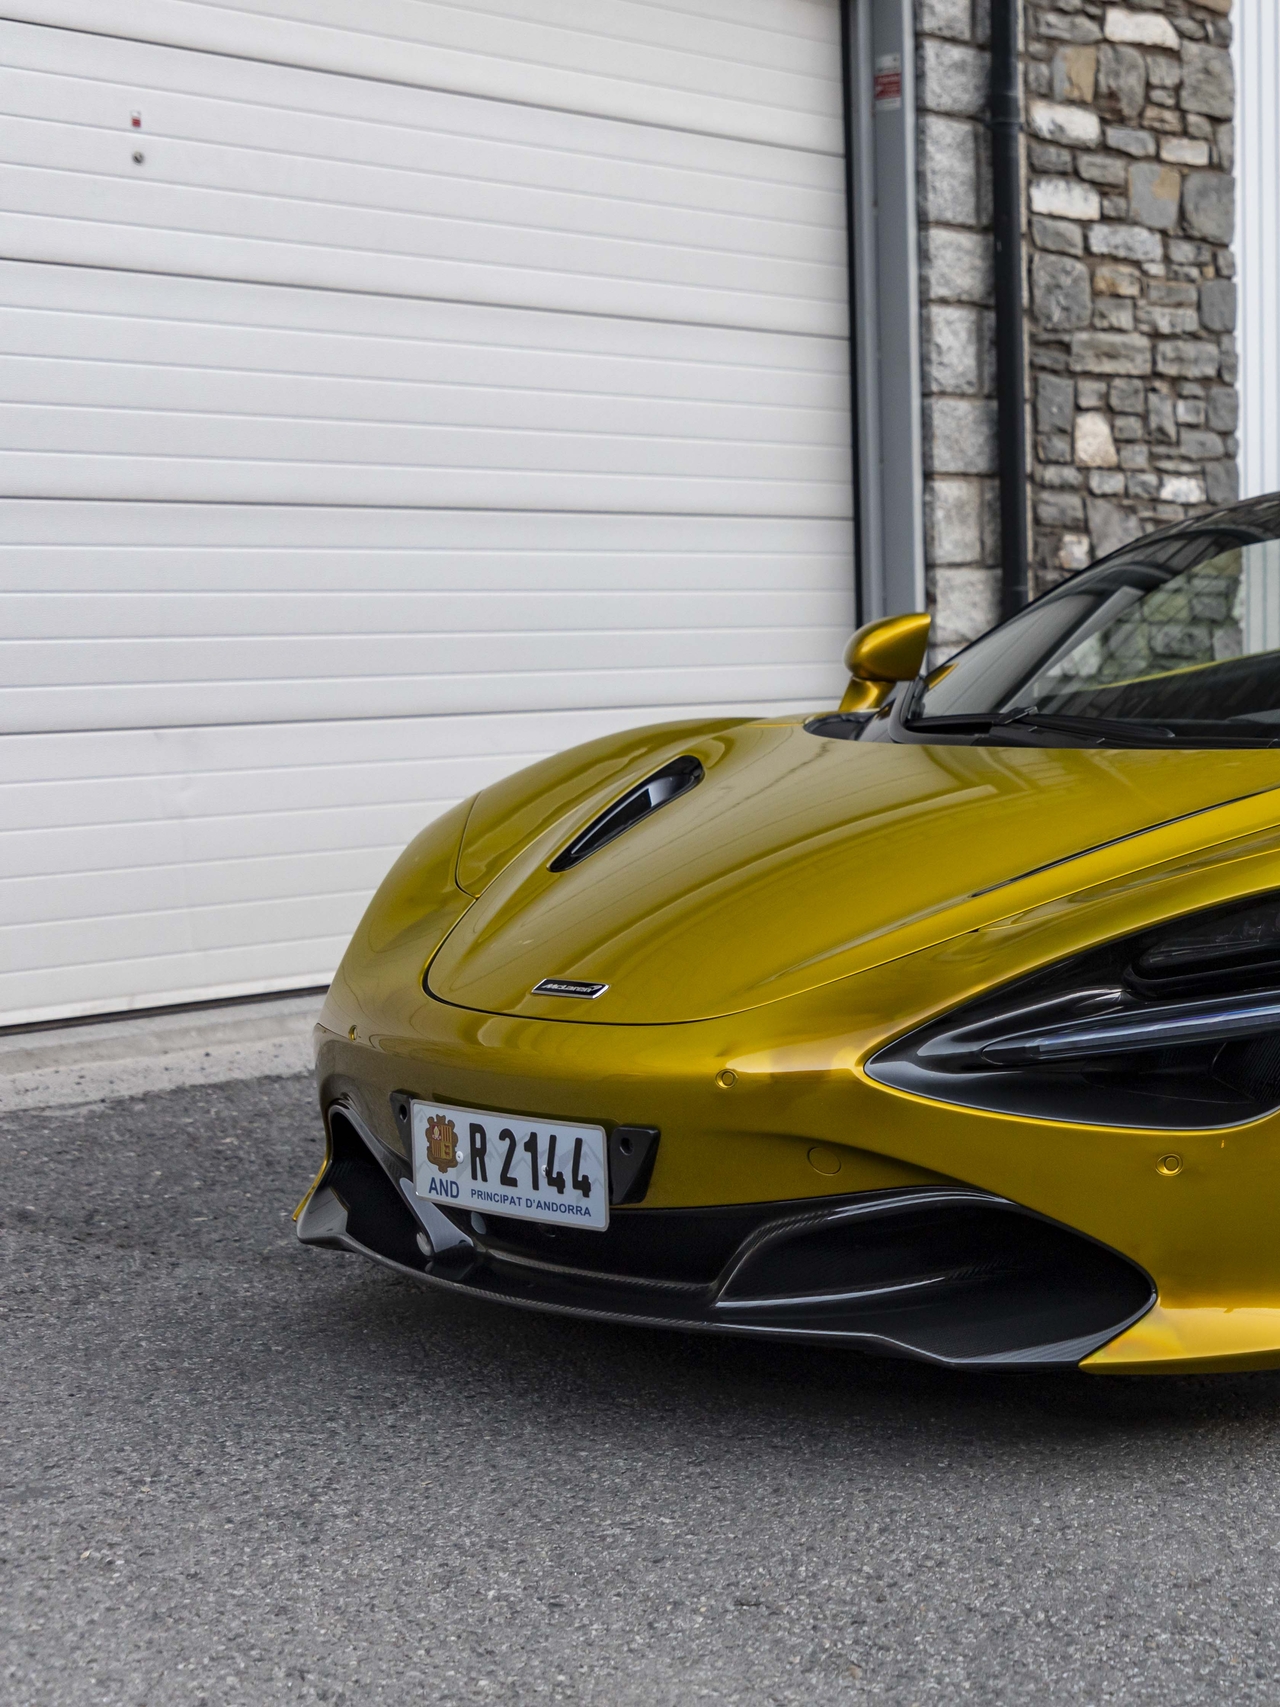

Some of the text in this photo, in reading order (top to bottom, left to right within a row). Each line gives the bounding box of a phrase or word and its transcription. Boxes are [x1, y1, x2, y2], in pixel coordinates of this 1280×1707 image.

[541, 983, 593, 993] McLaren
[469, 1122, 592, 1198] R 2144
[428, 1177, 460, 1199] AND
[471, 1188, 591, 1217] PRINCIPAT D'ANDORRA
